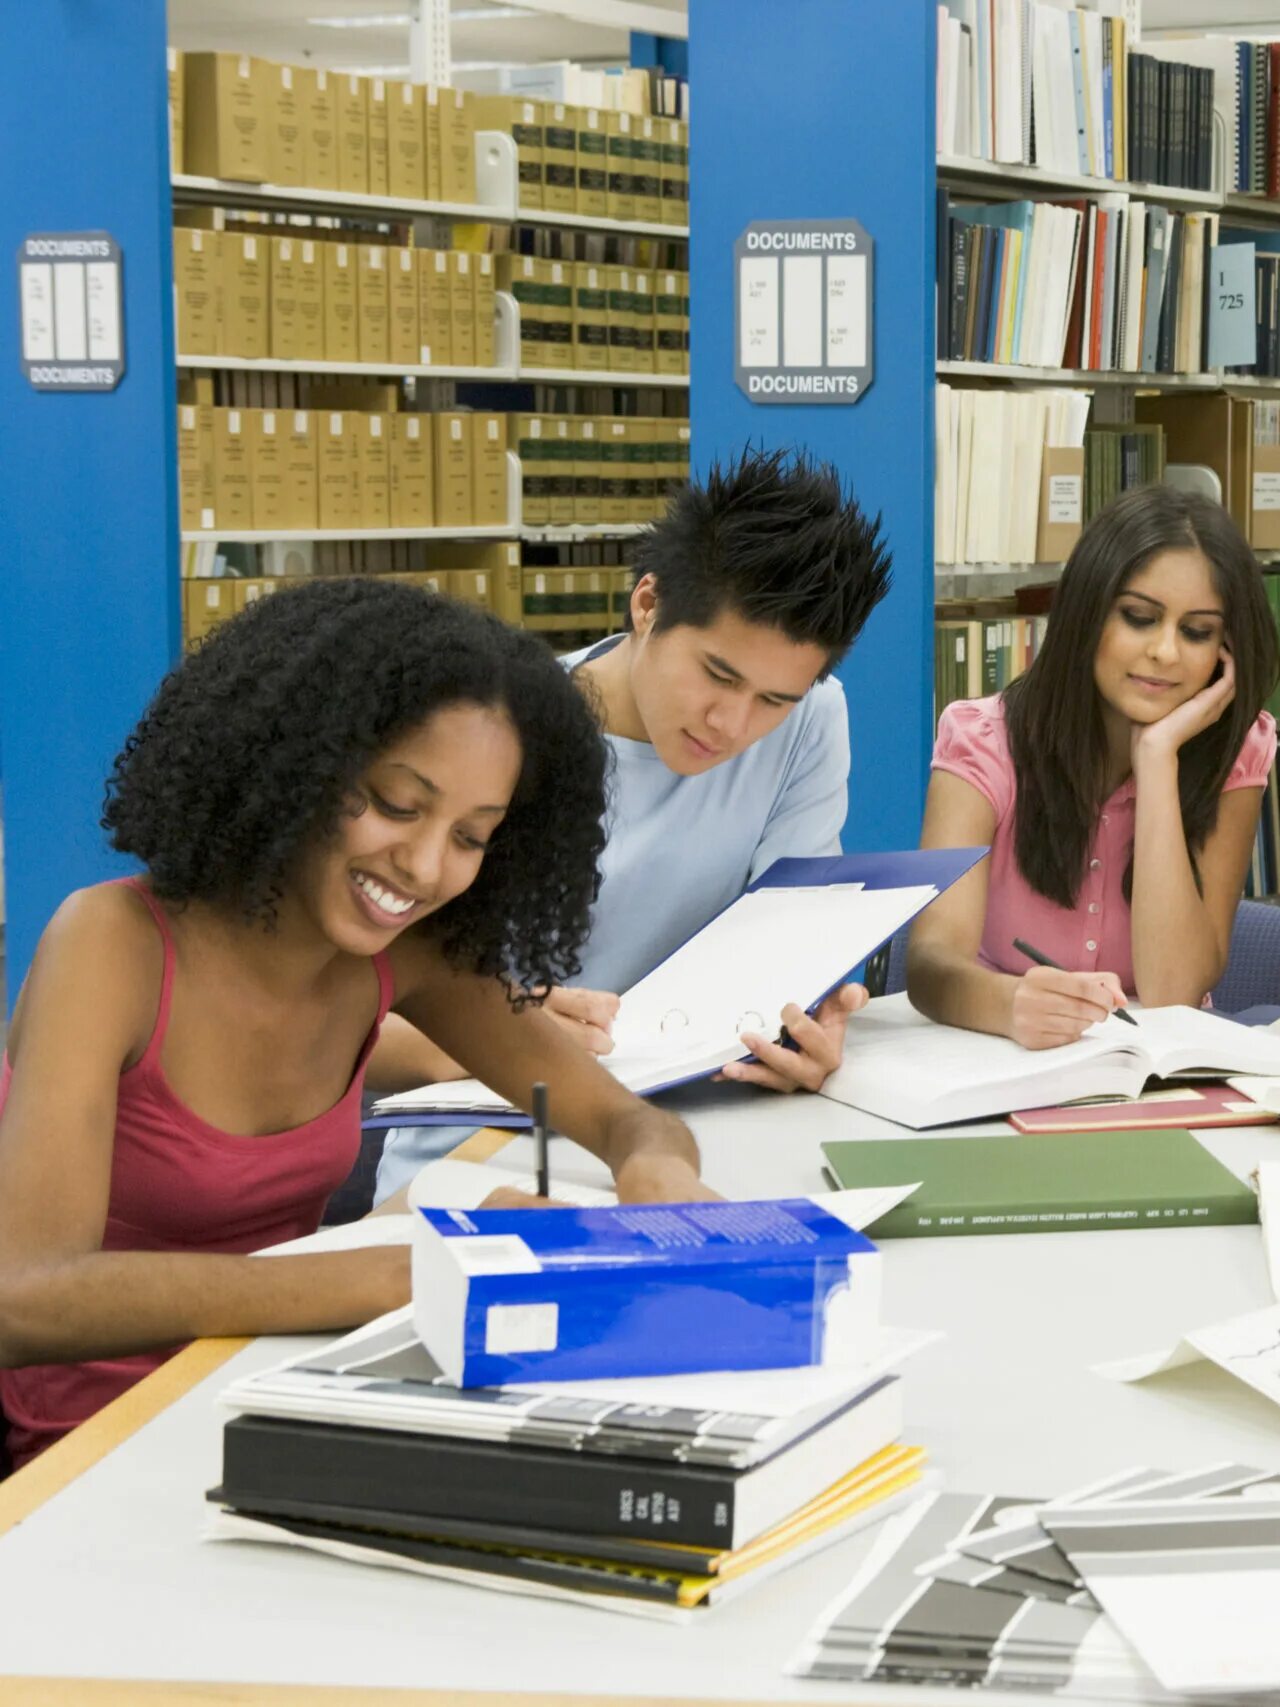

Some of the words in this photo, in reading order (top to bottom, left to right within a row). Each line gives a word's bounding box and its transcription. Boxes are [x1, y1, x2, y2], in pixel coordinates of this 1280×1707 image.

[25, 240, 110, 256] DOCUMENTS
[747, 232, 857, 250] DOCUMENTS
[1219, 294, 1244, 310] 725
[29, 367, 115, 384] DOCUMENTS
[749, 375, 858, 393] DOCUMENTS
